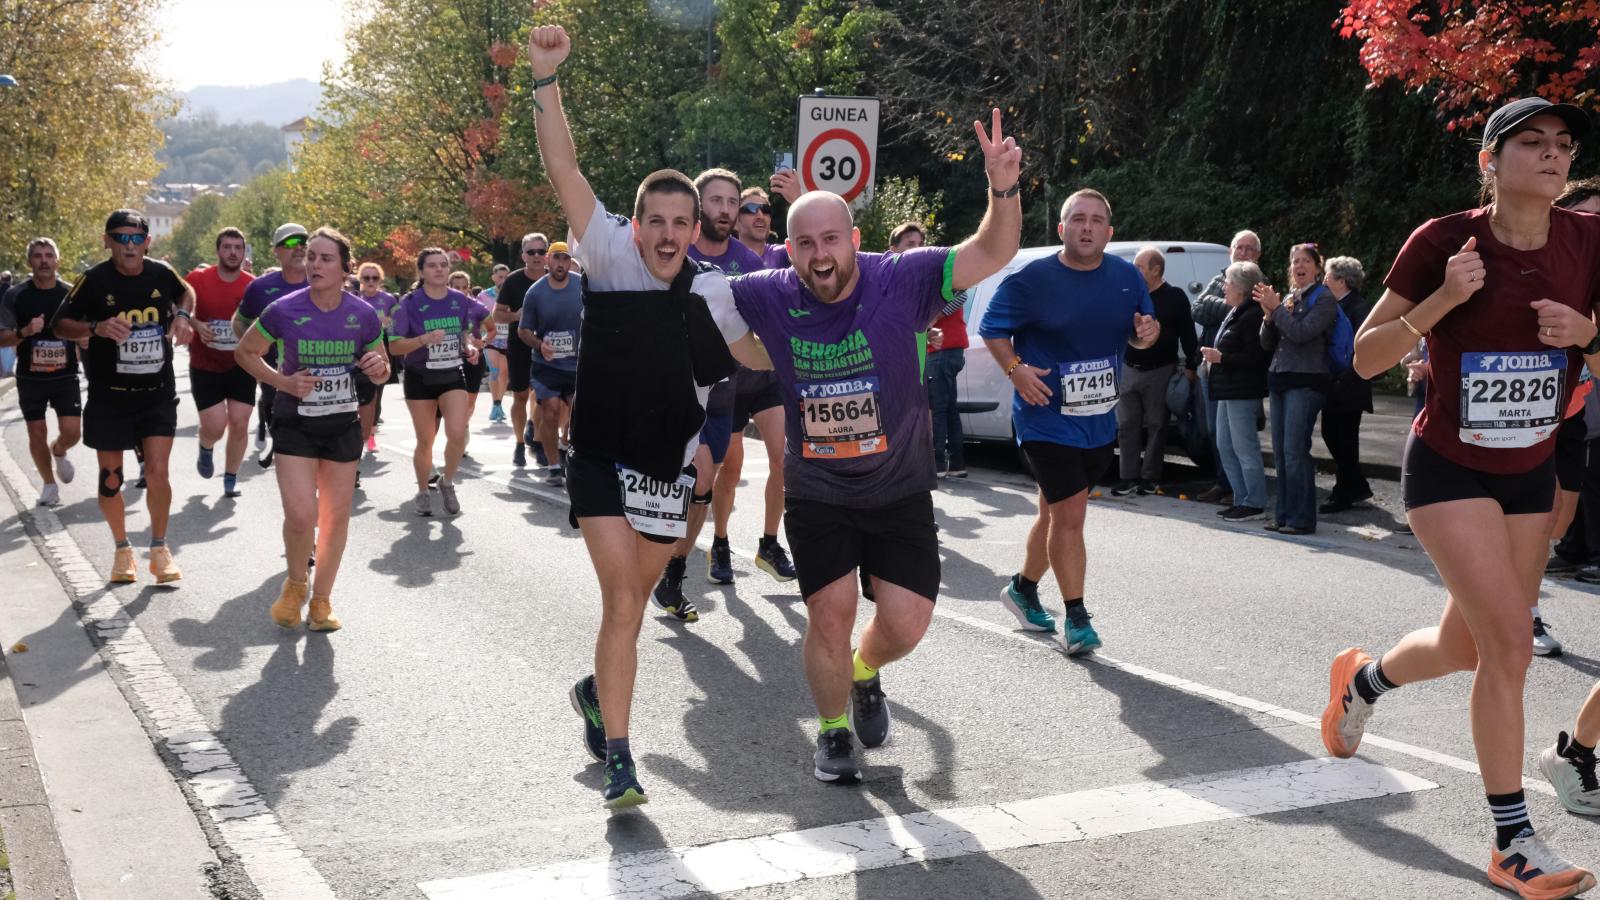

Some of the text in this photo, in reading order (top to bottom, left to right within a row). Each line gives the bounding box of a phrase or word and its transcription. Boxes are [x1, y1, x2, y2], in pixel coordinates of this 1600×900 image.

[811, 106, 868, 121] GUNEA
[819, 156, 856, 180] 30
[122, 339, 160, 353] 18777
[298, 339, 355, 355] BEHOBIA
[550, 337, 572, 346] 7230
[790, 328, 869, 359] BEHOBIA
[813, 347, 873, 371] SEBASTIAN
[314, 377, 349, 392] 9811
[1067, 372, 1113, 393] 17419
[1471, 377, 1556, 403] 22826
[807, 398, 875, 423] 15664
[1499, 409, 1532, 417] MARTA
[828, 426, 854, 434] LAURA
[626, 474, 684, 499] 24009
